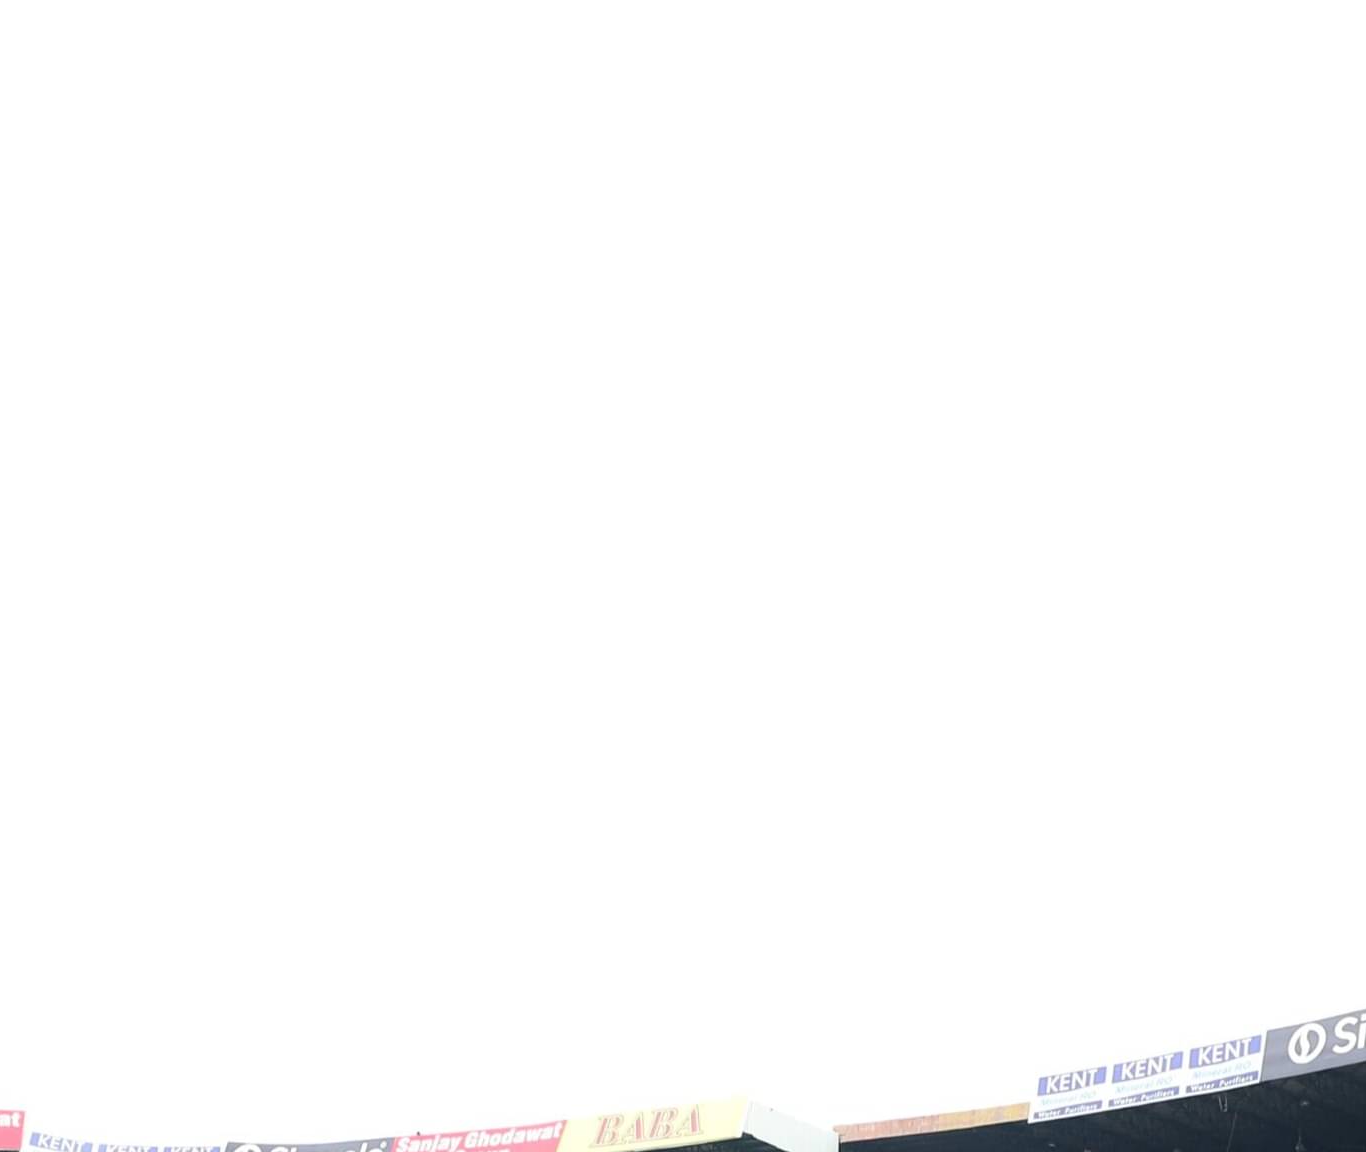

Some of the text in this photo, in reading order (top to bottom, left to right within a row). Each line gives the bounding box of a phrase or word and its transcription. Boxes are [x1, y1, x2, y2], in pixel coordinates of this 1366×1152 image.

[1196, 1039, 1253, 1066] KENT
[1119, 1054, 1176, 1080] KENT
[1045, 1070, 1099, 1095] KENT
[465, 1122, 564, 1149] Ghodawat
[590, 1104, 703, 1147] BABA
[37, 1135, 85, 1152] KENT
